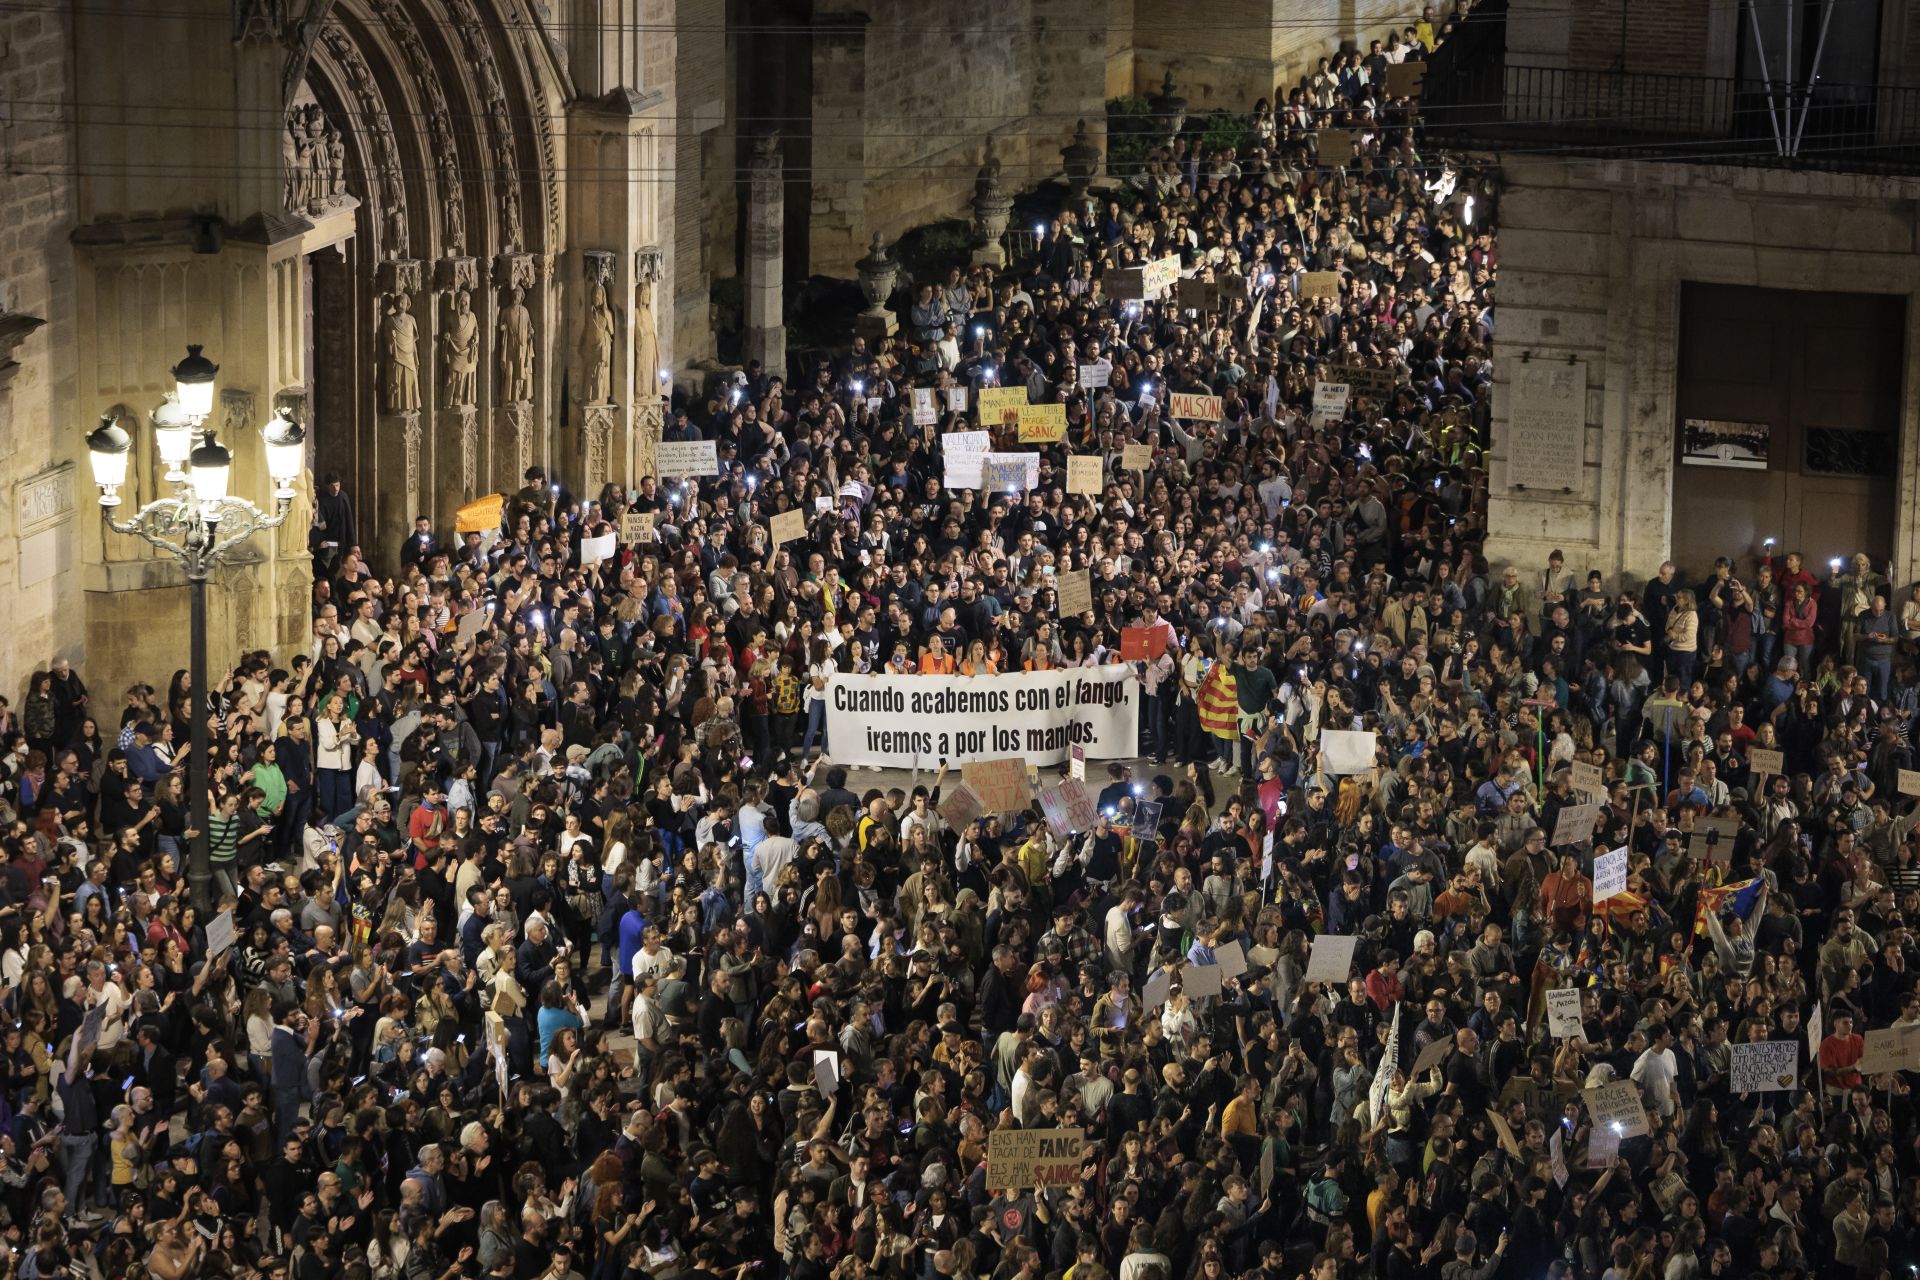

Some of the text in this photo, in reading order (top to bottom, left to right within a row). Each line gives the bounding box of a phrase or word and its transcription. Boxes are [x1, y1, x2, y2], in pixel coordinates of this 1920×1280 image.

[984, 399, 1005, 408] MANS
[1028, 425, 1057, 438] SANG
[834, 678, 1129, 714] Cuando acabemos con el fango,
[866, 719, 1098, 758] iremos a por los mandos.
[990, 760, 1019, 773] MALA
[992, 1131, 1037, 1146] ENS HAN
[993, 1146, 1037, 1159] TACAT DE
[1038, 1137, 1080, 1158] FANG
[990, 1161, 1030, 1175] ELS HAN
[1033, 1164, 1080, 1185] SANG
[990, 1174, 1032, 1187] TACAT DE
